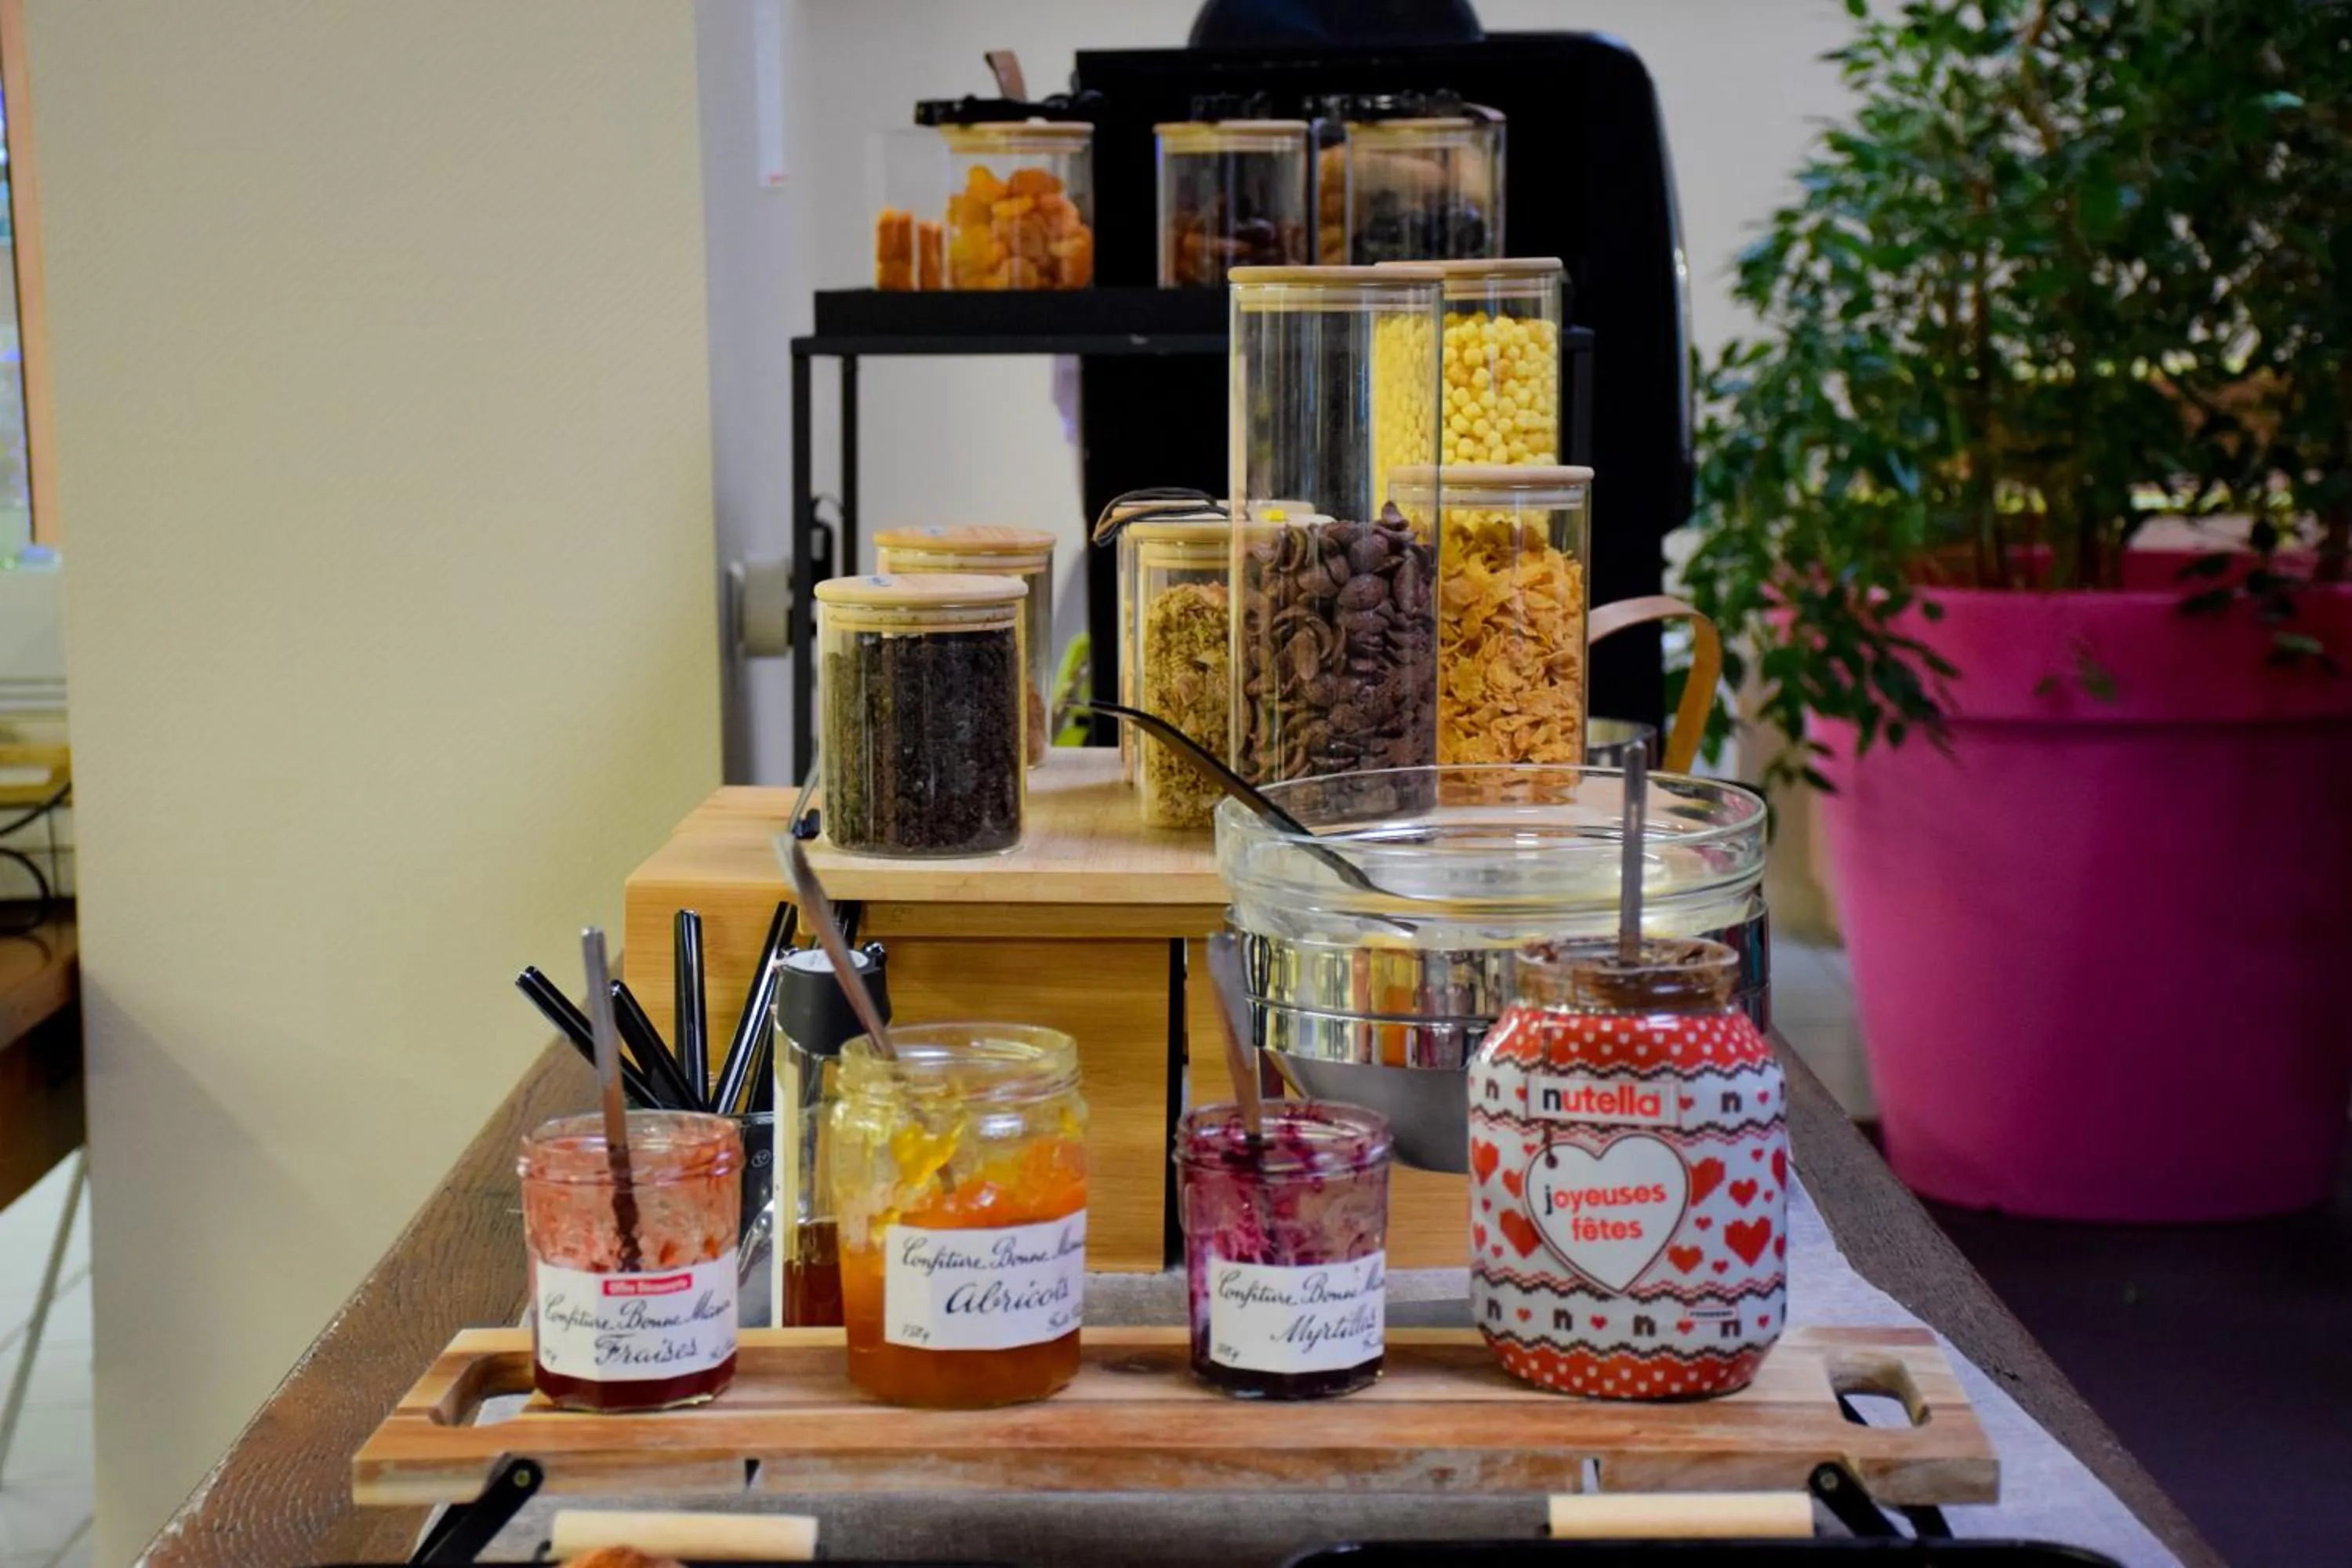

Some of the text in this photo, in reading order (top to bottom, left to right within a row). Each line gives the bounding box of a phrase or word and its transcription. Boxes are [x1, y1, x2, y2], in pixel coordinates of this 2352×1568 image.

[1543, 1084, 1661, 1118] nutella
[1721, 1091, 1742, 1112] n
[1544, 1183, 1667, 1215] joyeuses
[1571, 1217, 1643, 1242] fêtes
[902, 1236, 983, 1276] Confiture
[990, 1236, 1049, 1269] Bonne
[1218, 1269, 1295, 1308] Confiture
[618, 1299, 680, 1330] Bonne
[1553, 1308, 1573, 1330] n
[1633, 1313, 1656, 1338] n
[594, 1333, 699, 1366] Fraises
